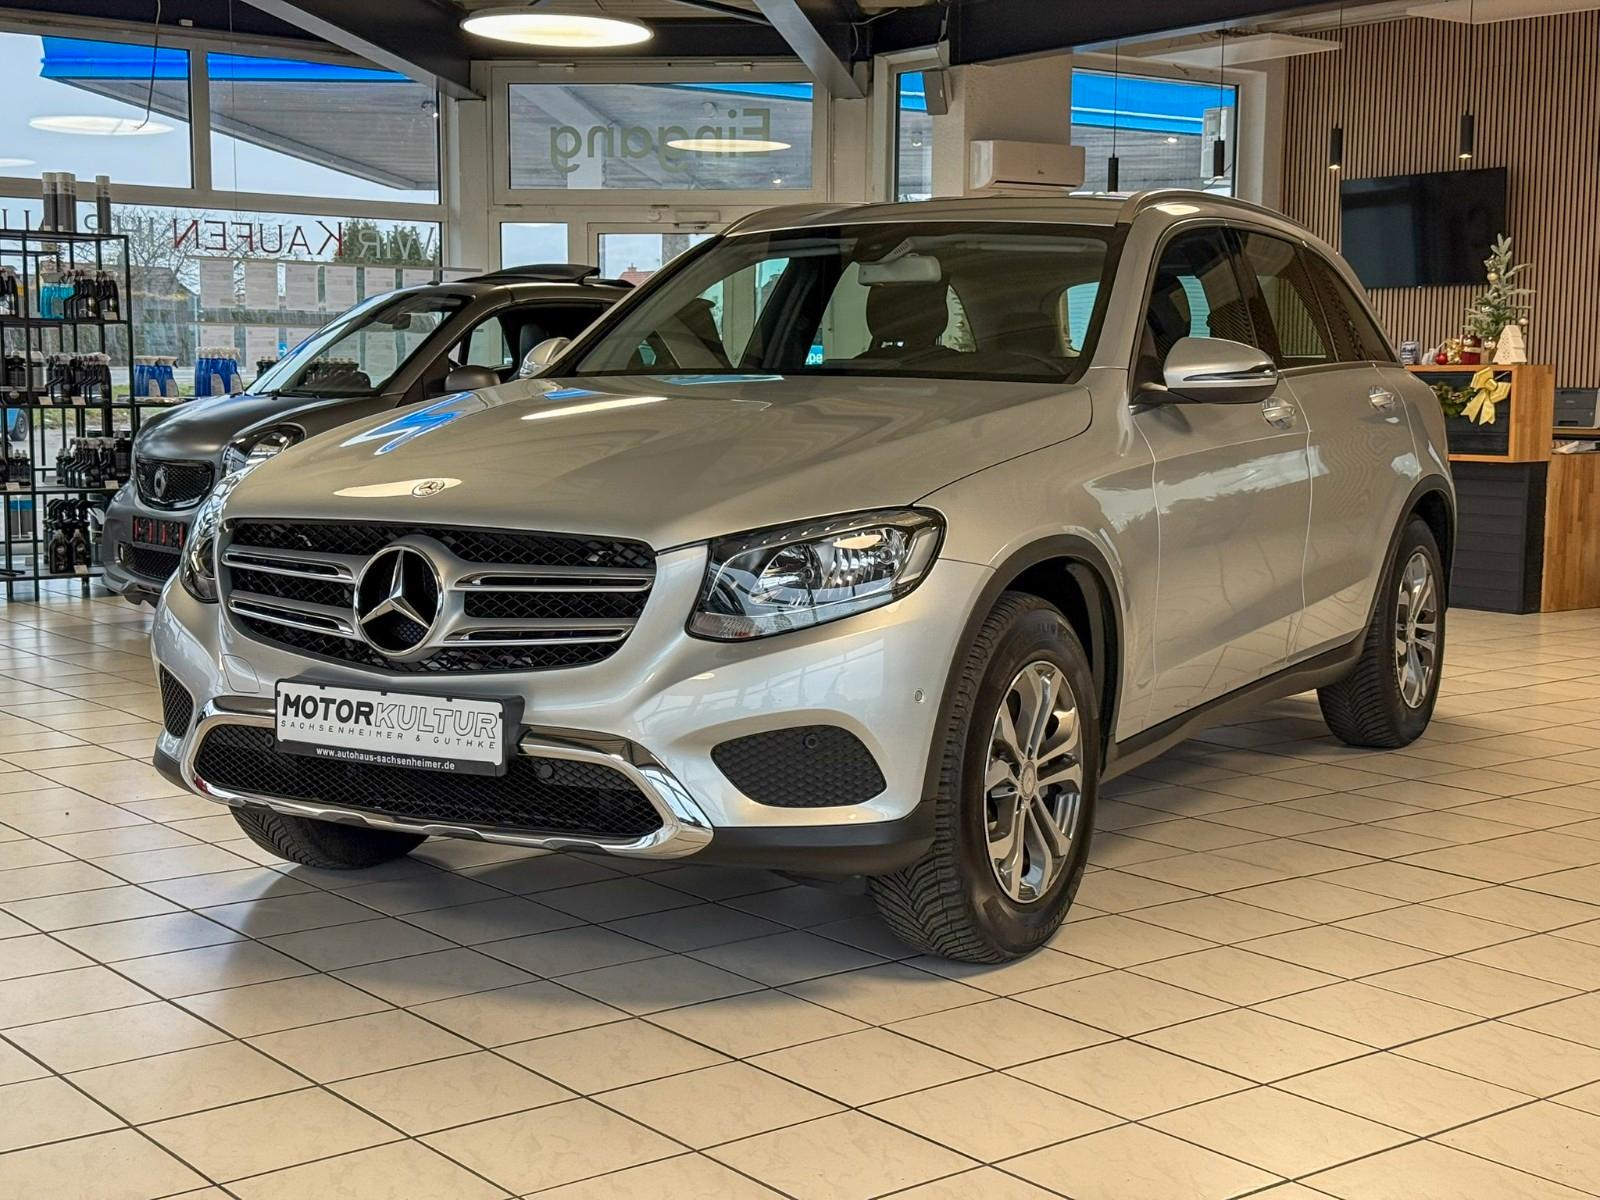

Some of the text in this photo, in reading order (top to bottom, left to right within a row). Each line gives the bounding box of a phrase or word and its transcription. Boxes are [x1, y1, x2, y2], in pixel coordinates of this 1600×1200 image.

[280, 720, 496, 749] SACHSENHEIMER & GUTHKE
[315, 747, 455, 771] www.autohaus-sachsenheimer.de
